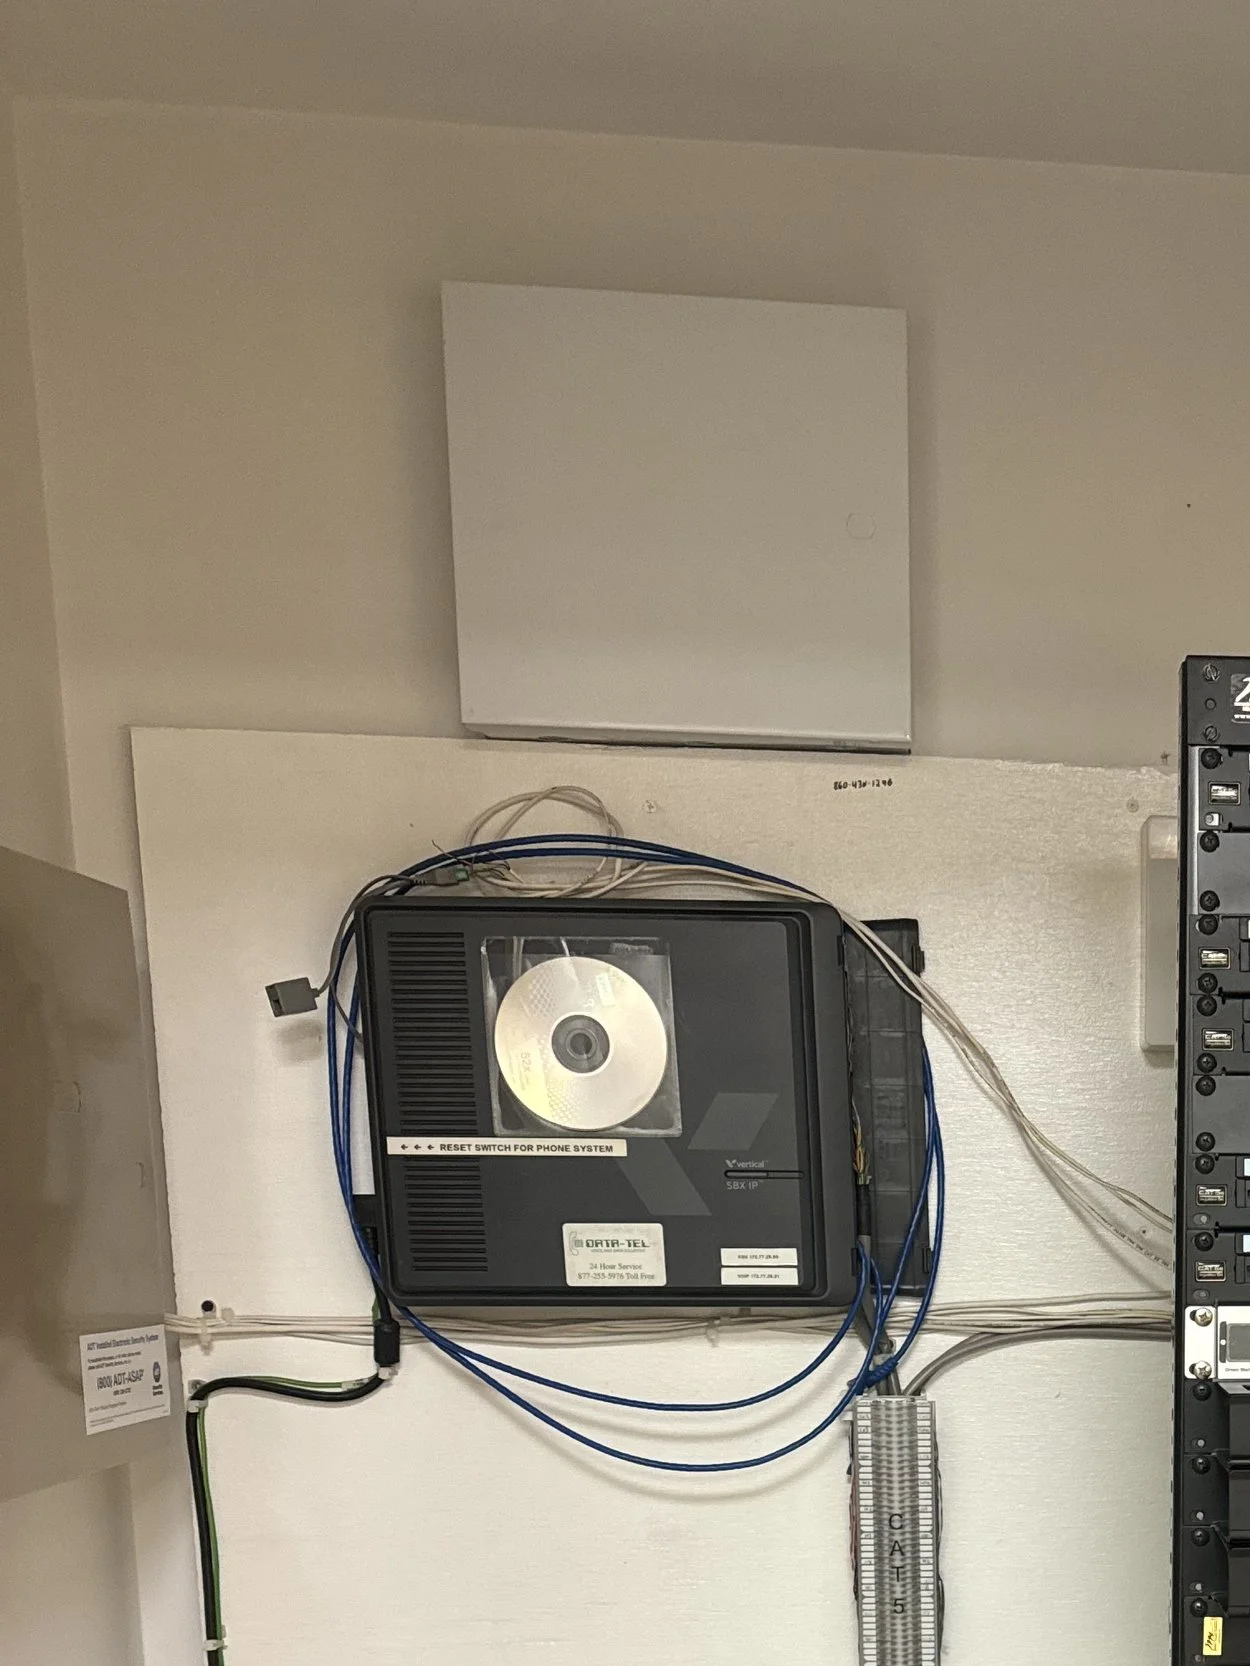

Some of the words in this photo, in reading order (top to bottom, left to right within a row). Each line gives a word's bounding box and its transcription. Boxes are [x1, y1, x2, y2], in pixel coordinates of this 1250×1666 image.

[440, 1143, 472, 1152] RESET
[475, 1143, 511, 1152] SWITCH
[514, 1144, 535, 1152] FOR
[536, 1144, 571, 1153] PHONE
[573, 1145, 613, 1153] SYSTEM
[736, 1160, 765, 1168] vertical
[726, 1181, 746, 1190] SBX
[749, 1181, 758, 1190] IP
[586, 1239, 650, 1248] DATA-TEL
[626, 1272, 639, 1280] Toll
[640, 1272, 655, 1280] Free
